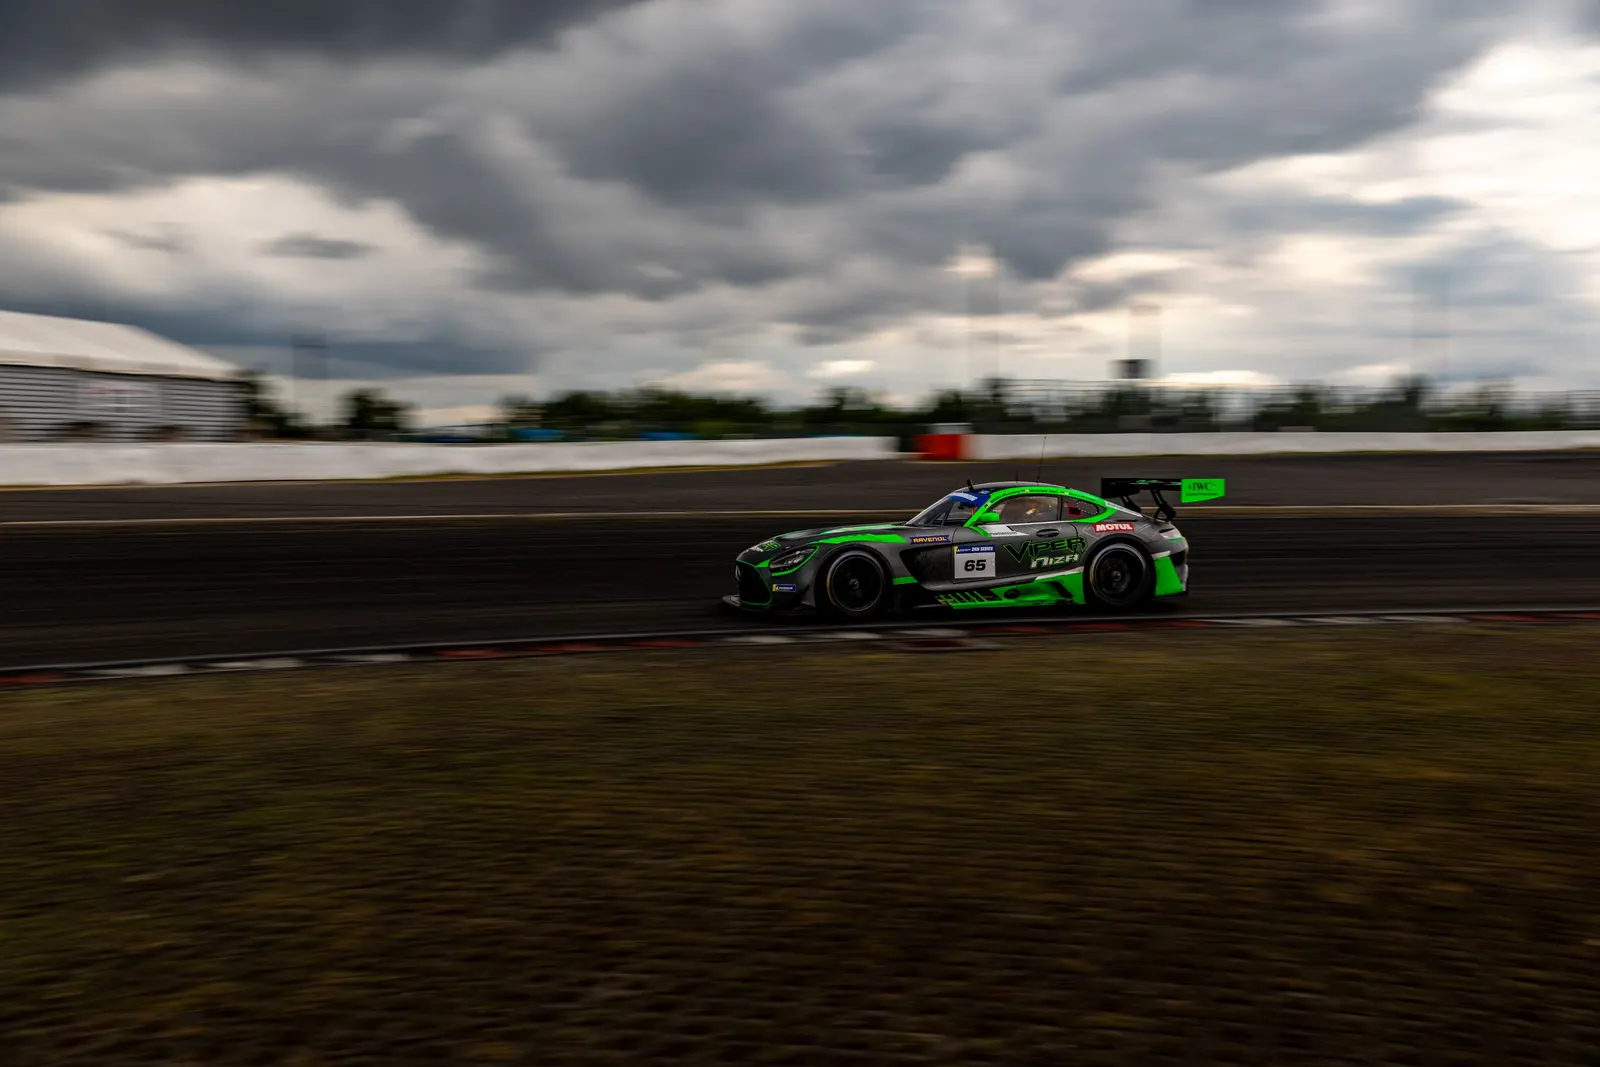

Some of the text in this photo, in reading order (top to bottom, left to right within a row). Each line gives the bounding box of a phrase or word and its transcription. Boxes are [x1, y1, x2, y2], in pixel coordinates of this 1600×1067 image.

[1096, 523, 1132, 532] MOTUL
[1003, 536, 1088, 563] VIPER
[964, 559, 986, 571] 65
